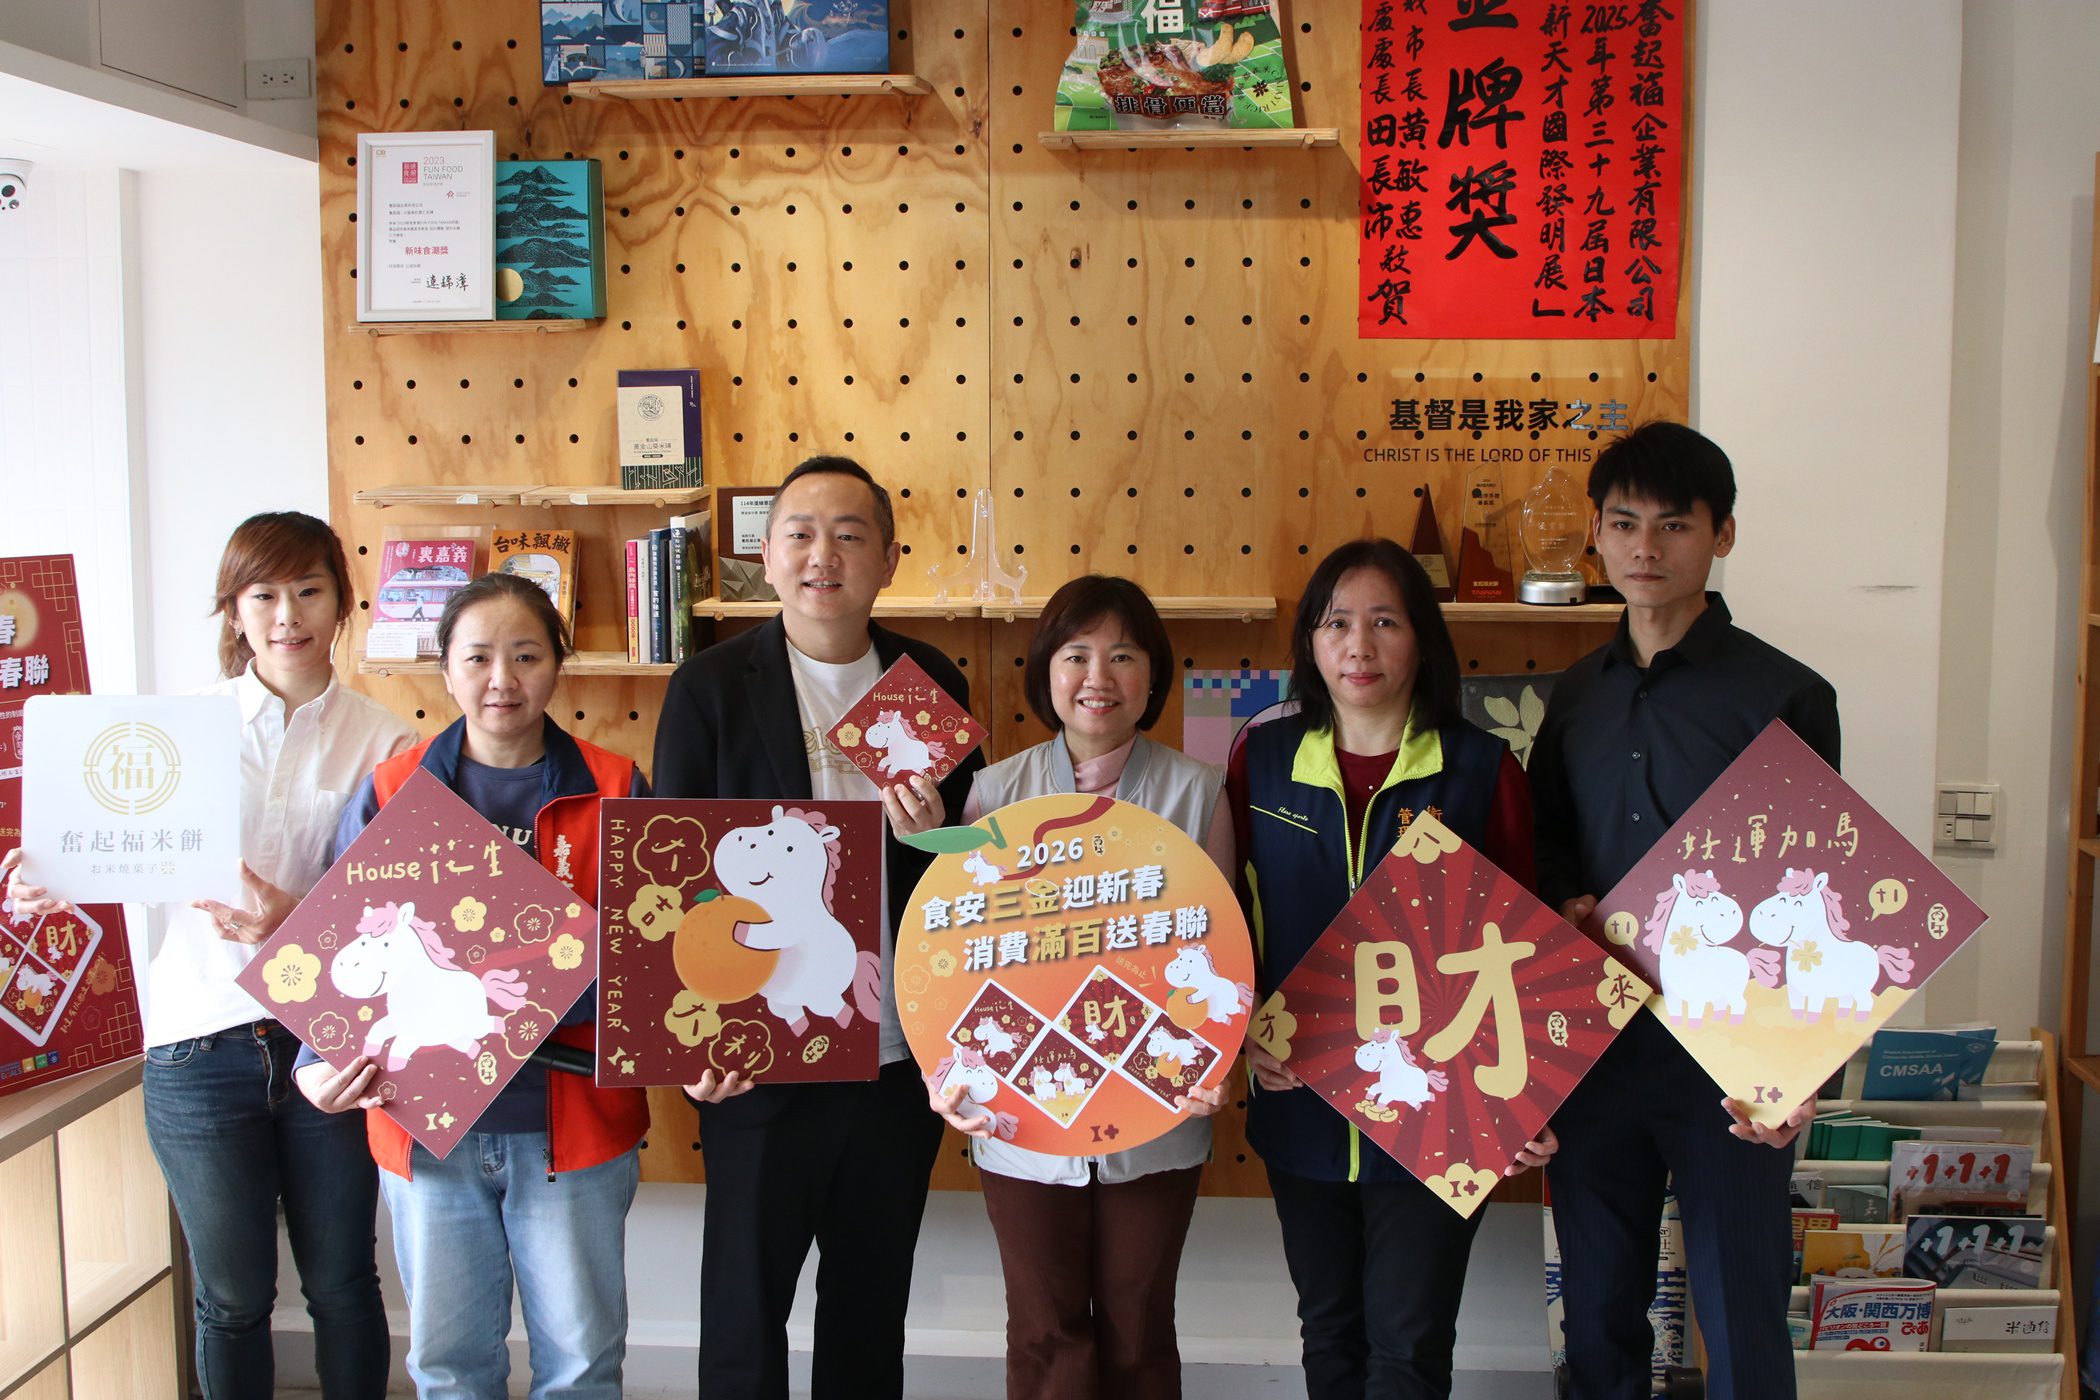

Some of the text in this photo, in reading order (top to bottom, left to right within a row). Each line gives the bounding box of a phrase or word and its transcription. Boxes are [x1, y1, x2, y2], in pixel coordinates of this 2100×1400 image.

[1115, 94, 1225, 116] 排骨便當
[423, 157, 445, 166] 2023
[423, 166, 464, 174] FUN FOOD
[423, 173, 453, 181] TAIWAN
[405, 246, 449, 256] 新味食潮獎
[1389, 398, 1630, 432] 基督是我家之主
[1364, 447, 1592, 463] CHRIST IS THE LORD OF THIS
[0, 654, 50, 689] 春聯
[107, 744, 155, 790] 福
[60, 828, 204, 854] 奮起福米餅
[1017, 837, 1084, 869] 2026
[1676, 812, 1859, 865] 好運加馬
[346, 860, 421, 885] House
[920, 864, 1164, 931] 食安三金迎新春
[607, 819, 626, 1028] HAPPY NEW YEAR
[963, 904, 1208, 972] 消費滿百送春聯
[1610, 973, 1641, 1010] 來
[1083, 995, 1128, 1038] 財
[1354, 922, 1536, 1100] 財
[1880, 1063, 1943, 1078] CMSAA
[1824, 1302, 1933, 1321] 大阪・関西万博
